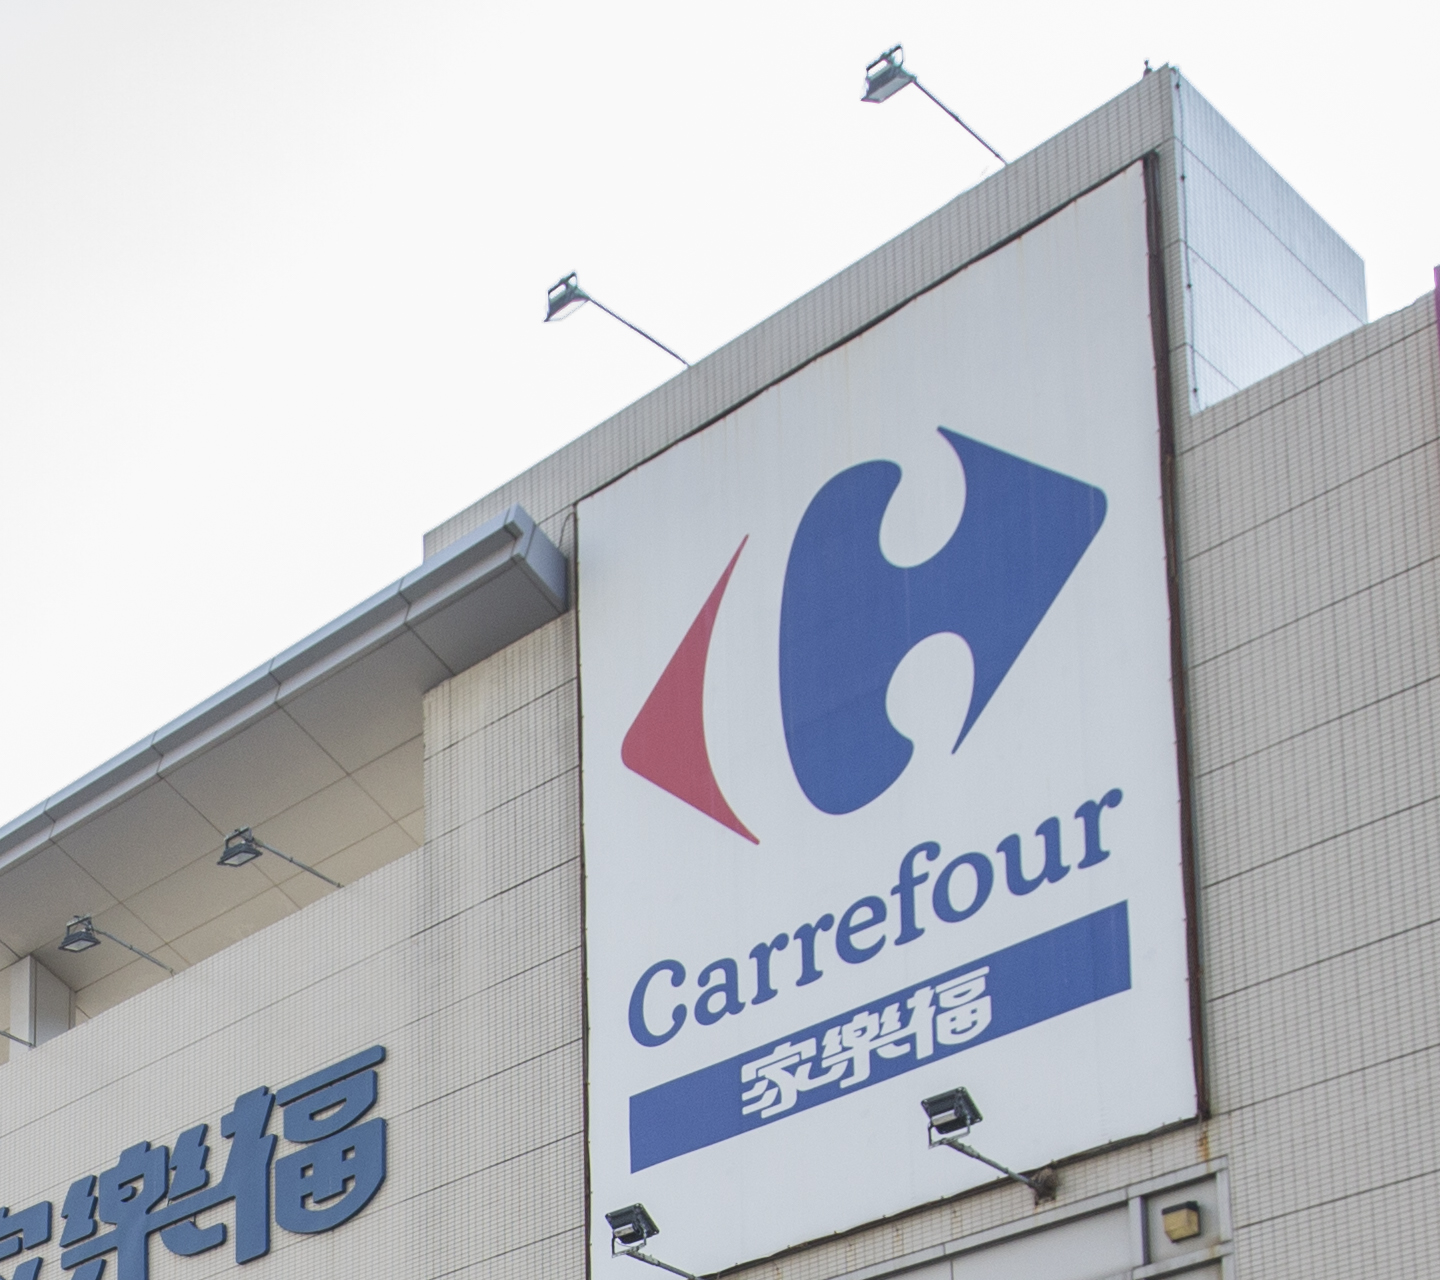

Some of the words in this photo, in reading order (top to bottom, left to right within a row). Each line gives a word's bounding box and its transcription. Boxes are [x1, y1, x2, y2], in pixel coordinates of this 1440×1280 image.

[628, 787, 1124, 1048] Carrefour
[741, 965, 992, 1119] 家樂福
